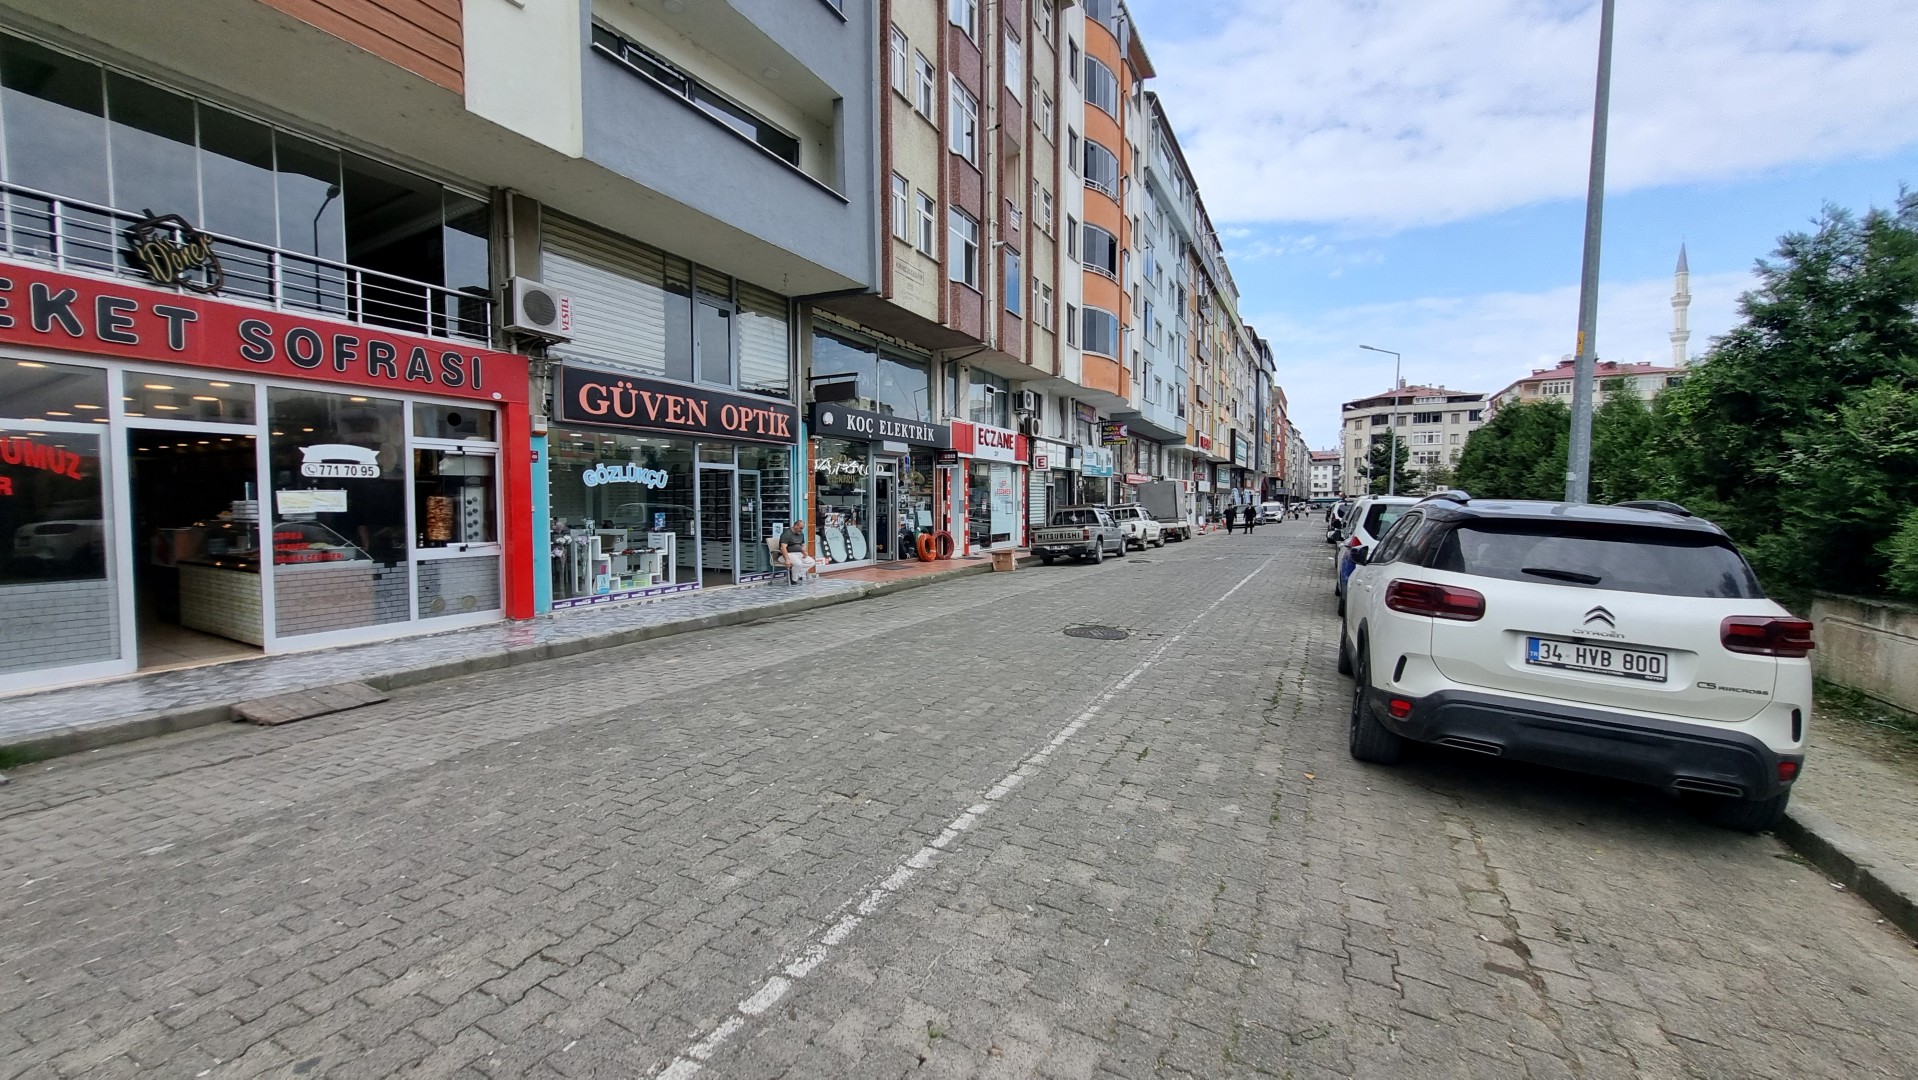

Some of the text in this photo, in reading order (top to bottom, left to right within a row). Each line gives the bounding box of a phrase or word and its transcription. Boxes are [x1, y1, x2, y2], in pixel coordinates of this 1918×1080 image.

[561, 297, 570, 331] VESTEL
[238, 318, 482, 390] SOFRASI
[578, 380, 791, 438] GÜVEN OPTİK
[846, 414, 935, 442] KOÇ ELEKTRİK
[978, 428, 1013, 450] ECZANE
[318, 464, 375, 477] 771 70 95
[582, 462, 668, 489] GÖZLÜKÇÜ
[1037, 532, 1080, 540] MITSUBISHI
[1540, 643, 1562, 661] 34
[1575, 647, 1612, 667] HVB
[1623, 653, 1661, 674] 800
